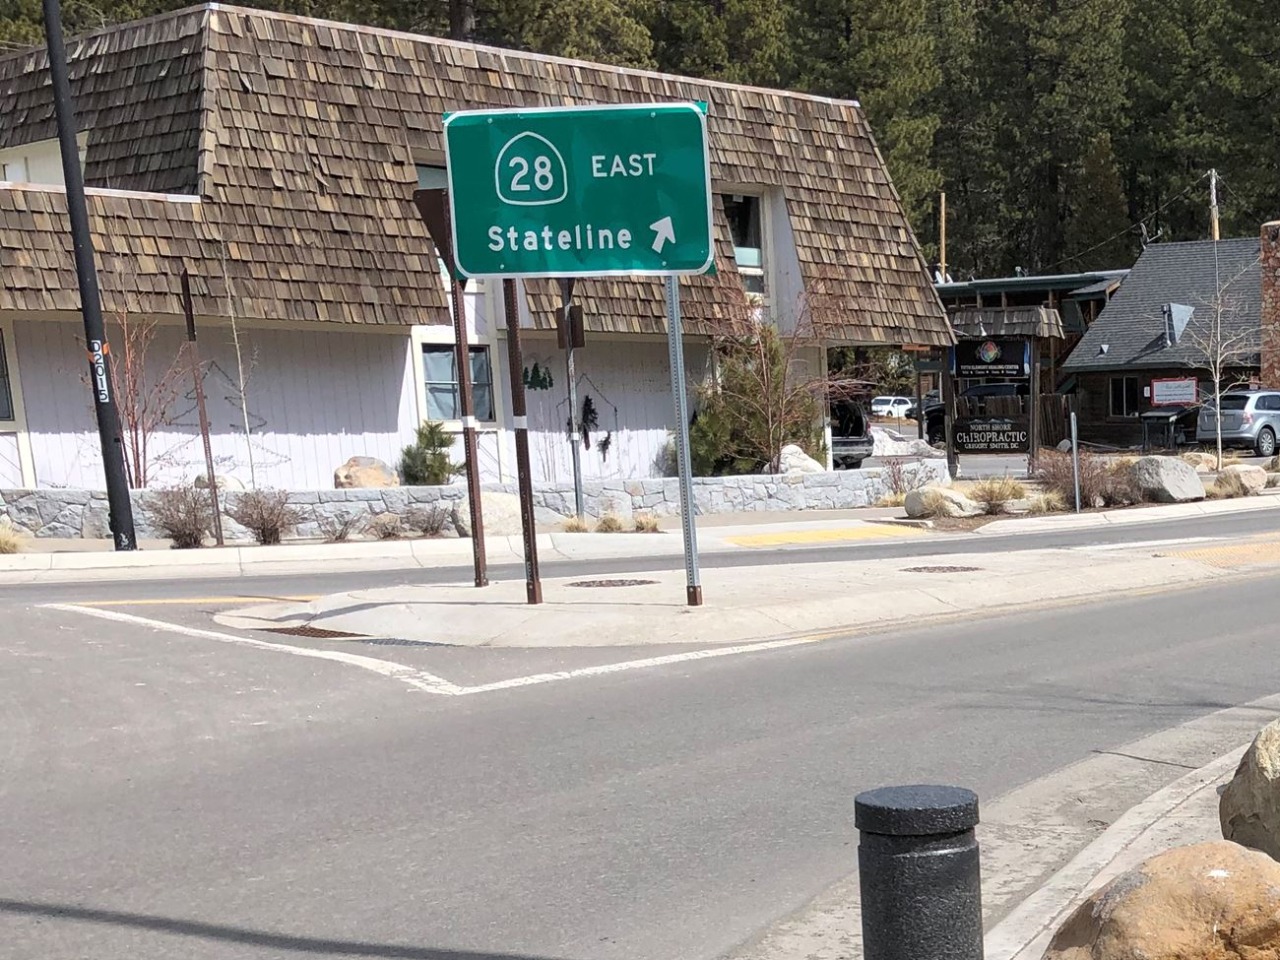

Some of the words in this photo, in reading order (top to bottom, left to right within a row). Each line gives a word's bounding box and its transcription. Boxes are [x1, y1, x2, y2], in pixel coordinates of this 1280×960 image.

[508, 155, 554, 192] 28
[591, 153, 657, 178] EAST
[487, 224, 632, 253] Stateline
